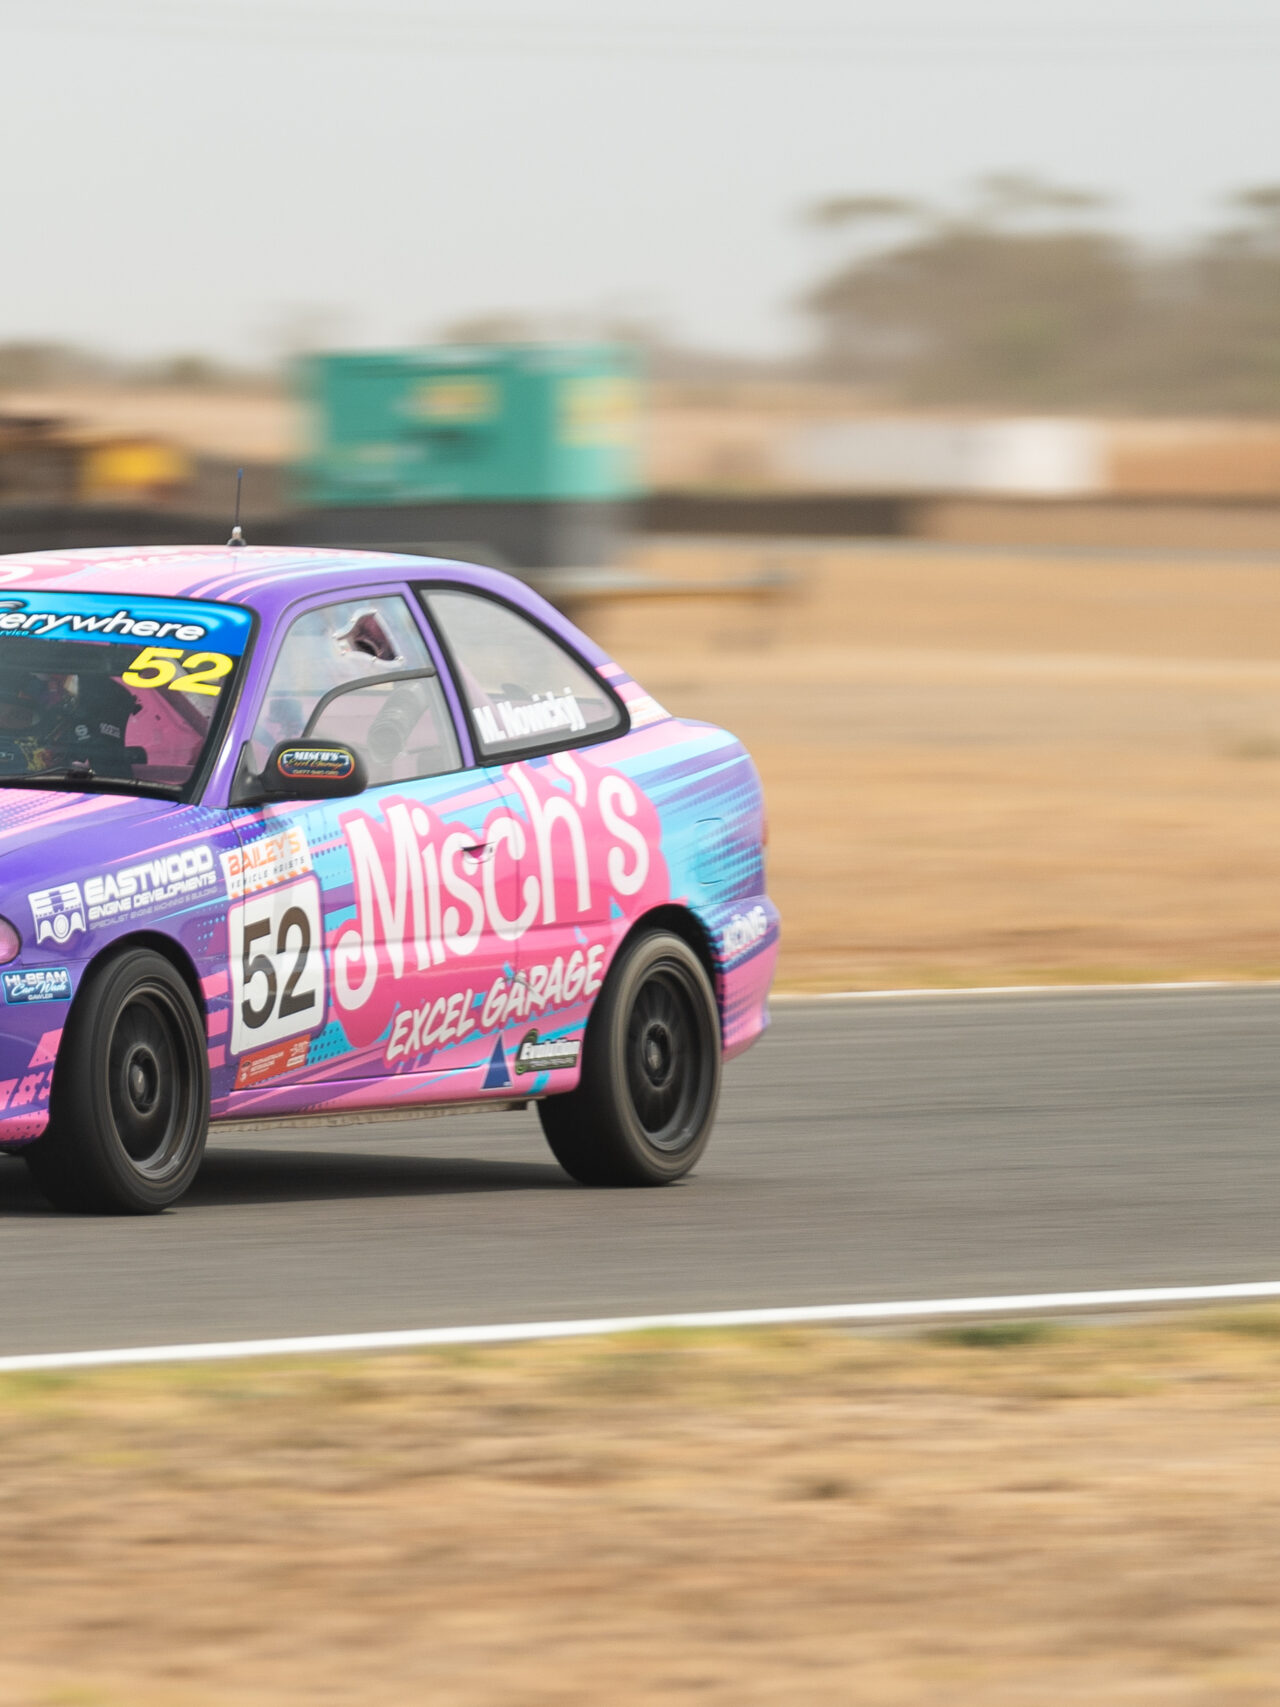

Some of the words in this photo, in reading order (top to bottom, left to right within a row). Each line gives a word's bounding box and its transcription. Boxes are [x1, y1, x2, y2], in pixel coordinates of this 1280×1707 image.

[122, 647, 233, 696] 52
[85, 845, 213, 906] EASTWOOD
[87, 897, 132, 920] ENGINE
[132, 870, 217, 908] DEVELOPMENTS
[334, 751, 650, 1011] Misch's
[4, 970, 68, 987] HI-BEAM
[11, 983, 35, 996] Car
[241, 906, 316, 1030] 52
[386, 988, 476, 1061] EXCEL
[481, 943, 605, 1027] GARAGE
